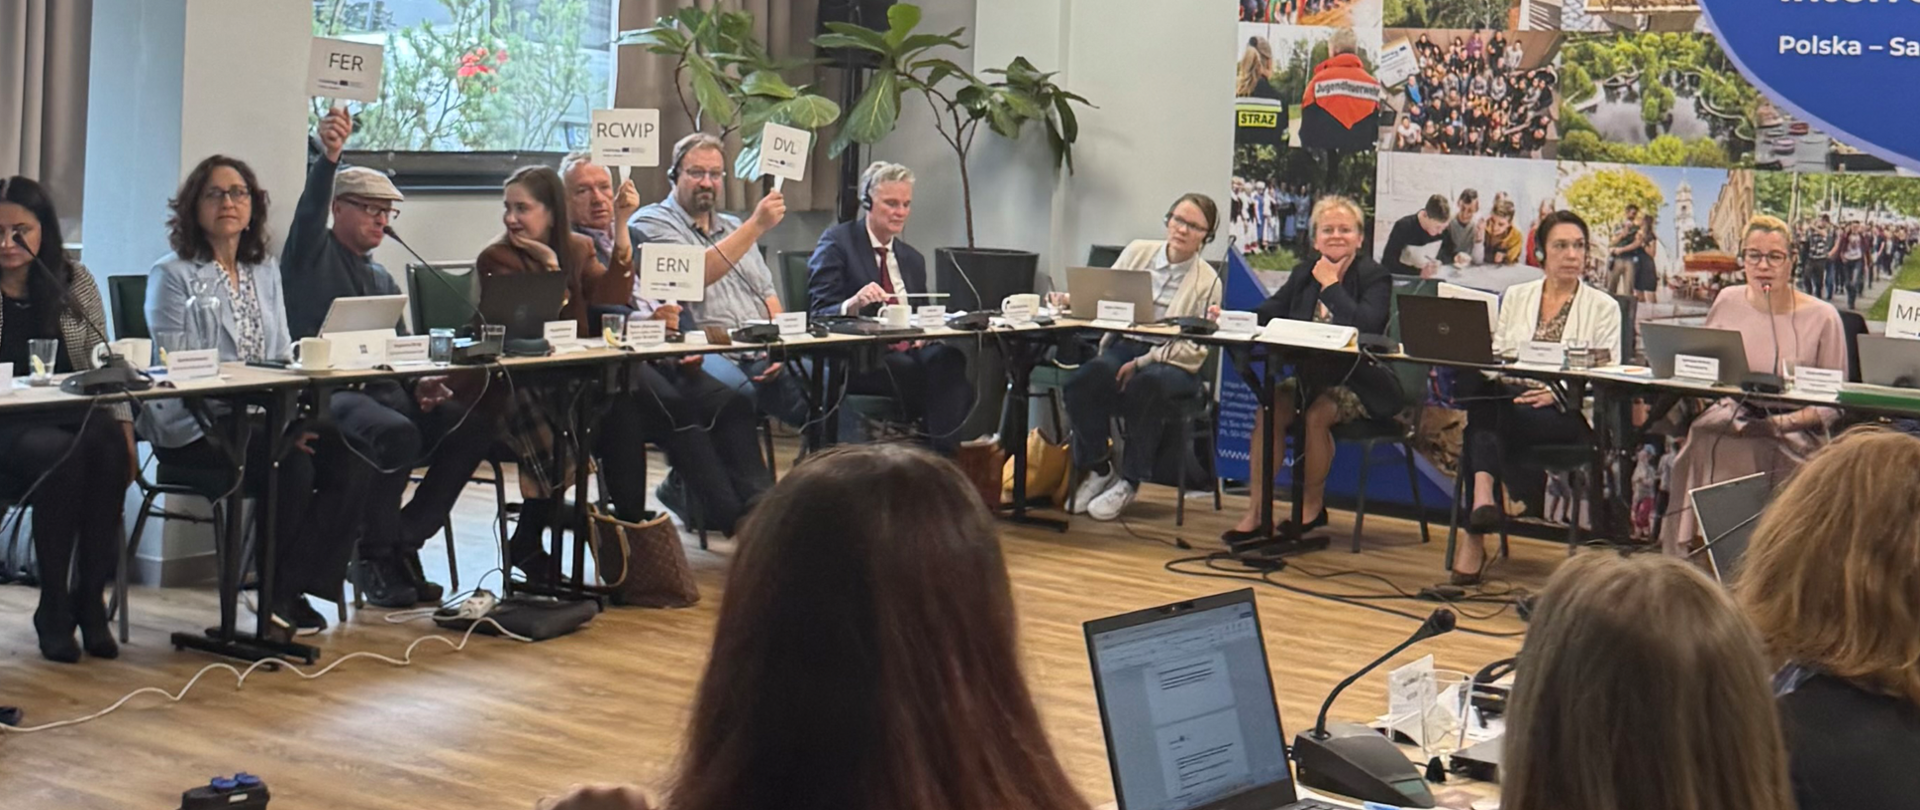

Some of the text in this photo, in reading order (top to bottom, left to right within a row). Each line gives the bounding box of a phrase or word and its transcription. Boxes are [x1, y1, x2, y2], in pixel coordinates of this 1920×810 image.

[1778, 35, 1862, 55] Polska
[328, 52, 364, 71] FER
[597, 122, 655, 138] RCWIP
[773, 137, 797, 155] DVL
[656, 257, 690, 273] ERN
